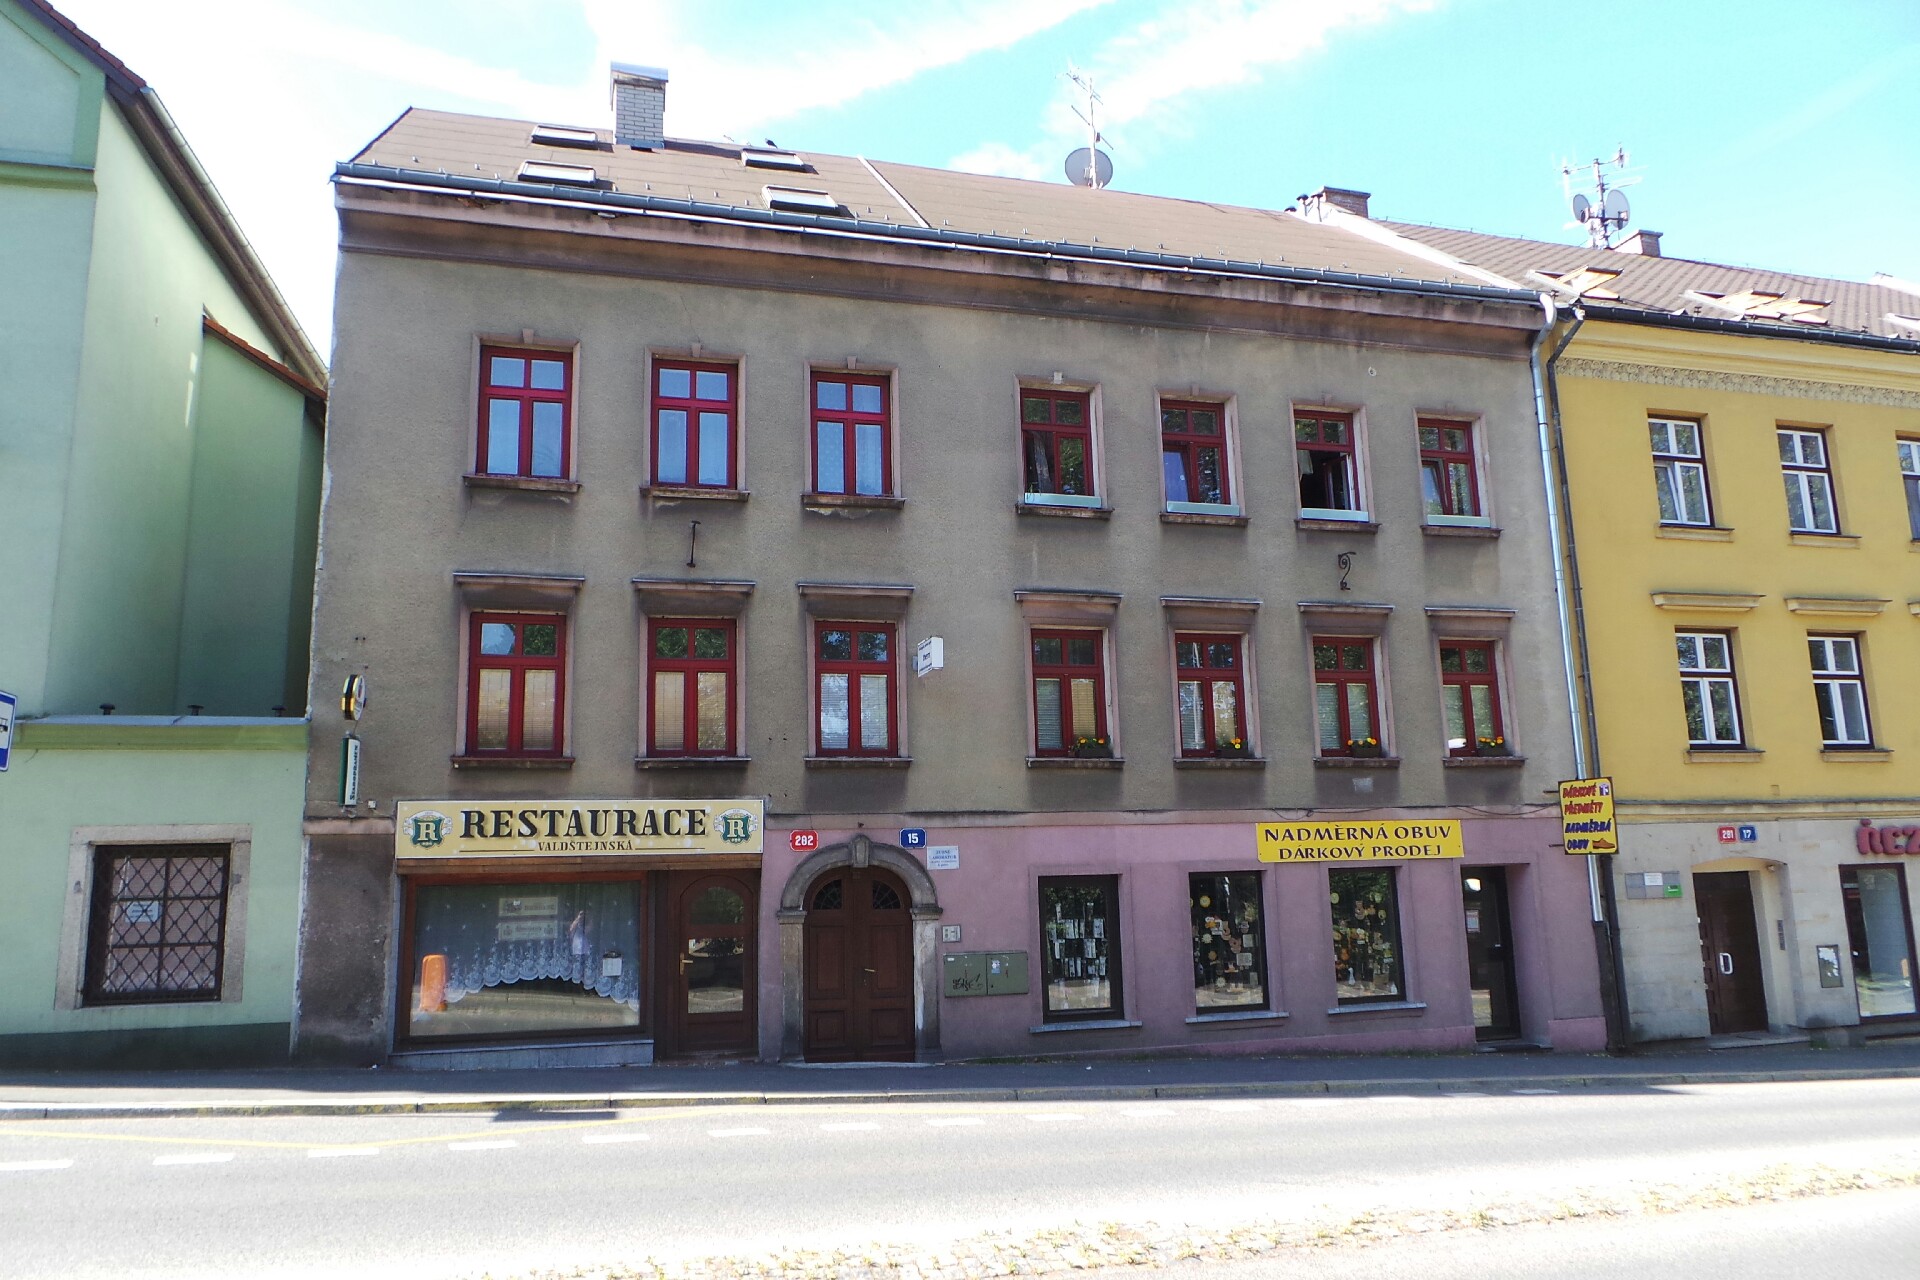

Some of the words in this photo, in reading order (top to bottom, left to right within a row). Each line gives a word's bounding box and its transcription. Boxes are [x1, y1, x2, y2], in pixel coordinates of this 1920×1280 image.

[460, 809, 706, 838] RESTAURACE
[727, 819, 745, 838] R
[416, 822, 438, 841] R
[908, 833, 918, 843] 15
[1394, 825, 1451, 839] OBUV
[1742, 829, 1752, 839] 17
[538, 840, 633, 852] VALDŠTEJNSKÁ
[795, 835, 813, 845] 282
[1567, 838, 1589, 850] OBUV
[1279, 843, 1365, 860] DÁRKOVÝ
[1372, 844, 1442, 857] PRODEJ
